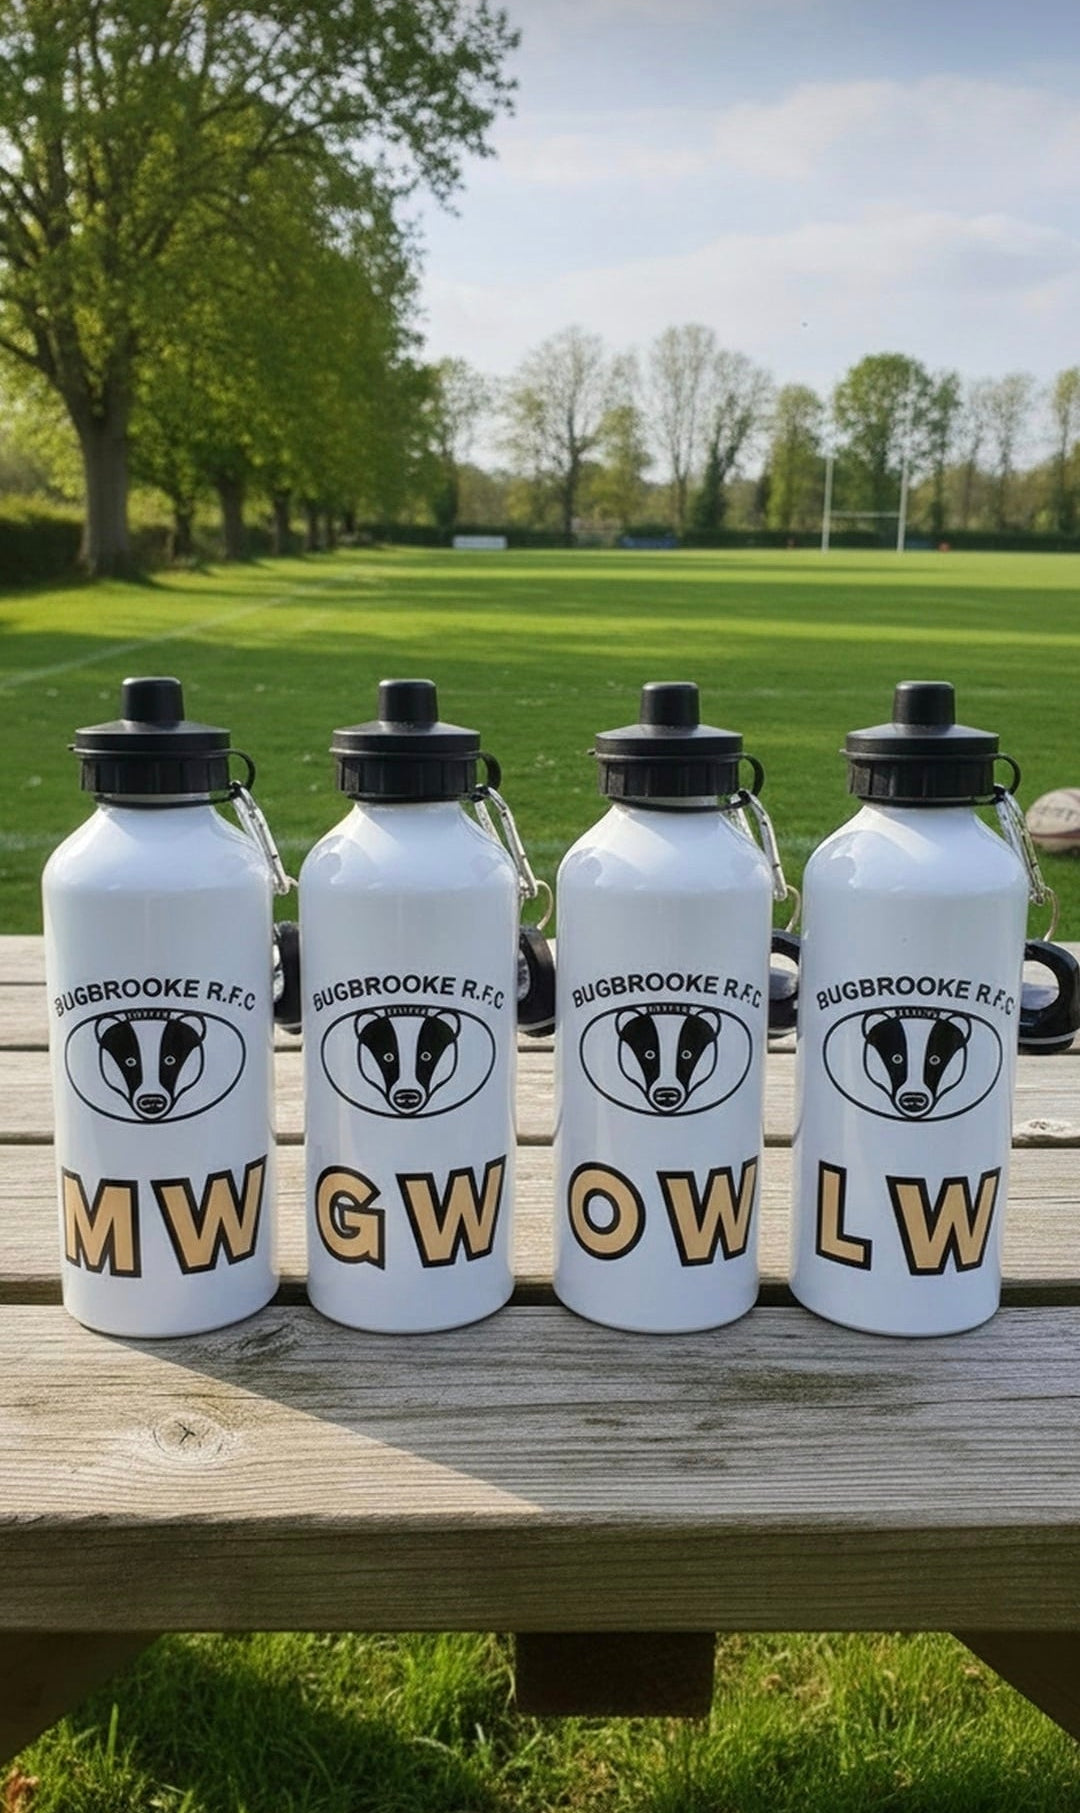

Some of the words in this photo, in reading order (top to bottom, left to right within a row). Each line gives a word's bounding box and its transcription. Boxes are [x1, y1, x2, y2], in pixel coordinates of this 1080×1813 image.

[55, 978, 200, 1017] BUGBROOKE
[207, 982, 255, 1011] R.F.C
[313, 974, 456, 1012] BUGBROOKE
[461, 979, 505, 1010] R.F.C
[572, 972, 719, 1009] BUGBROOKE
[816, 976, 971, 1011] BUGBROOKE
